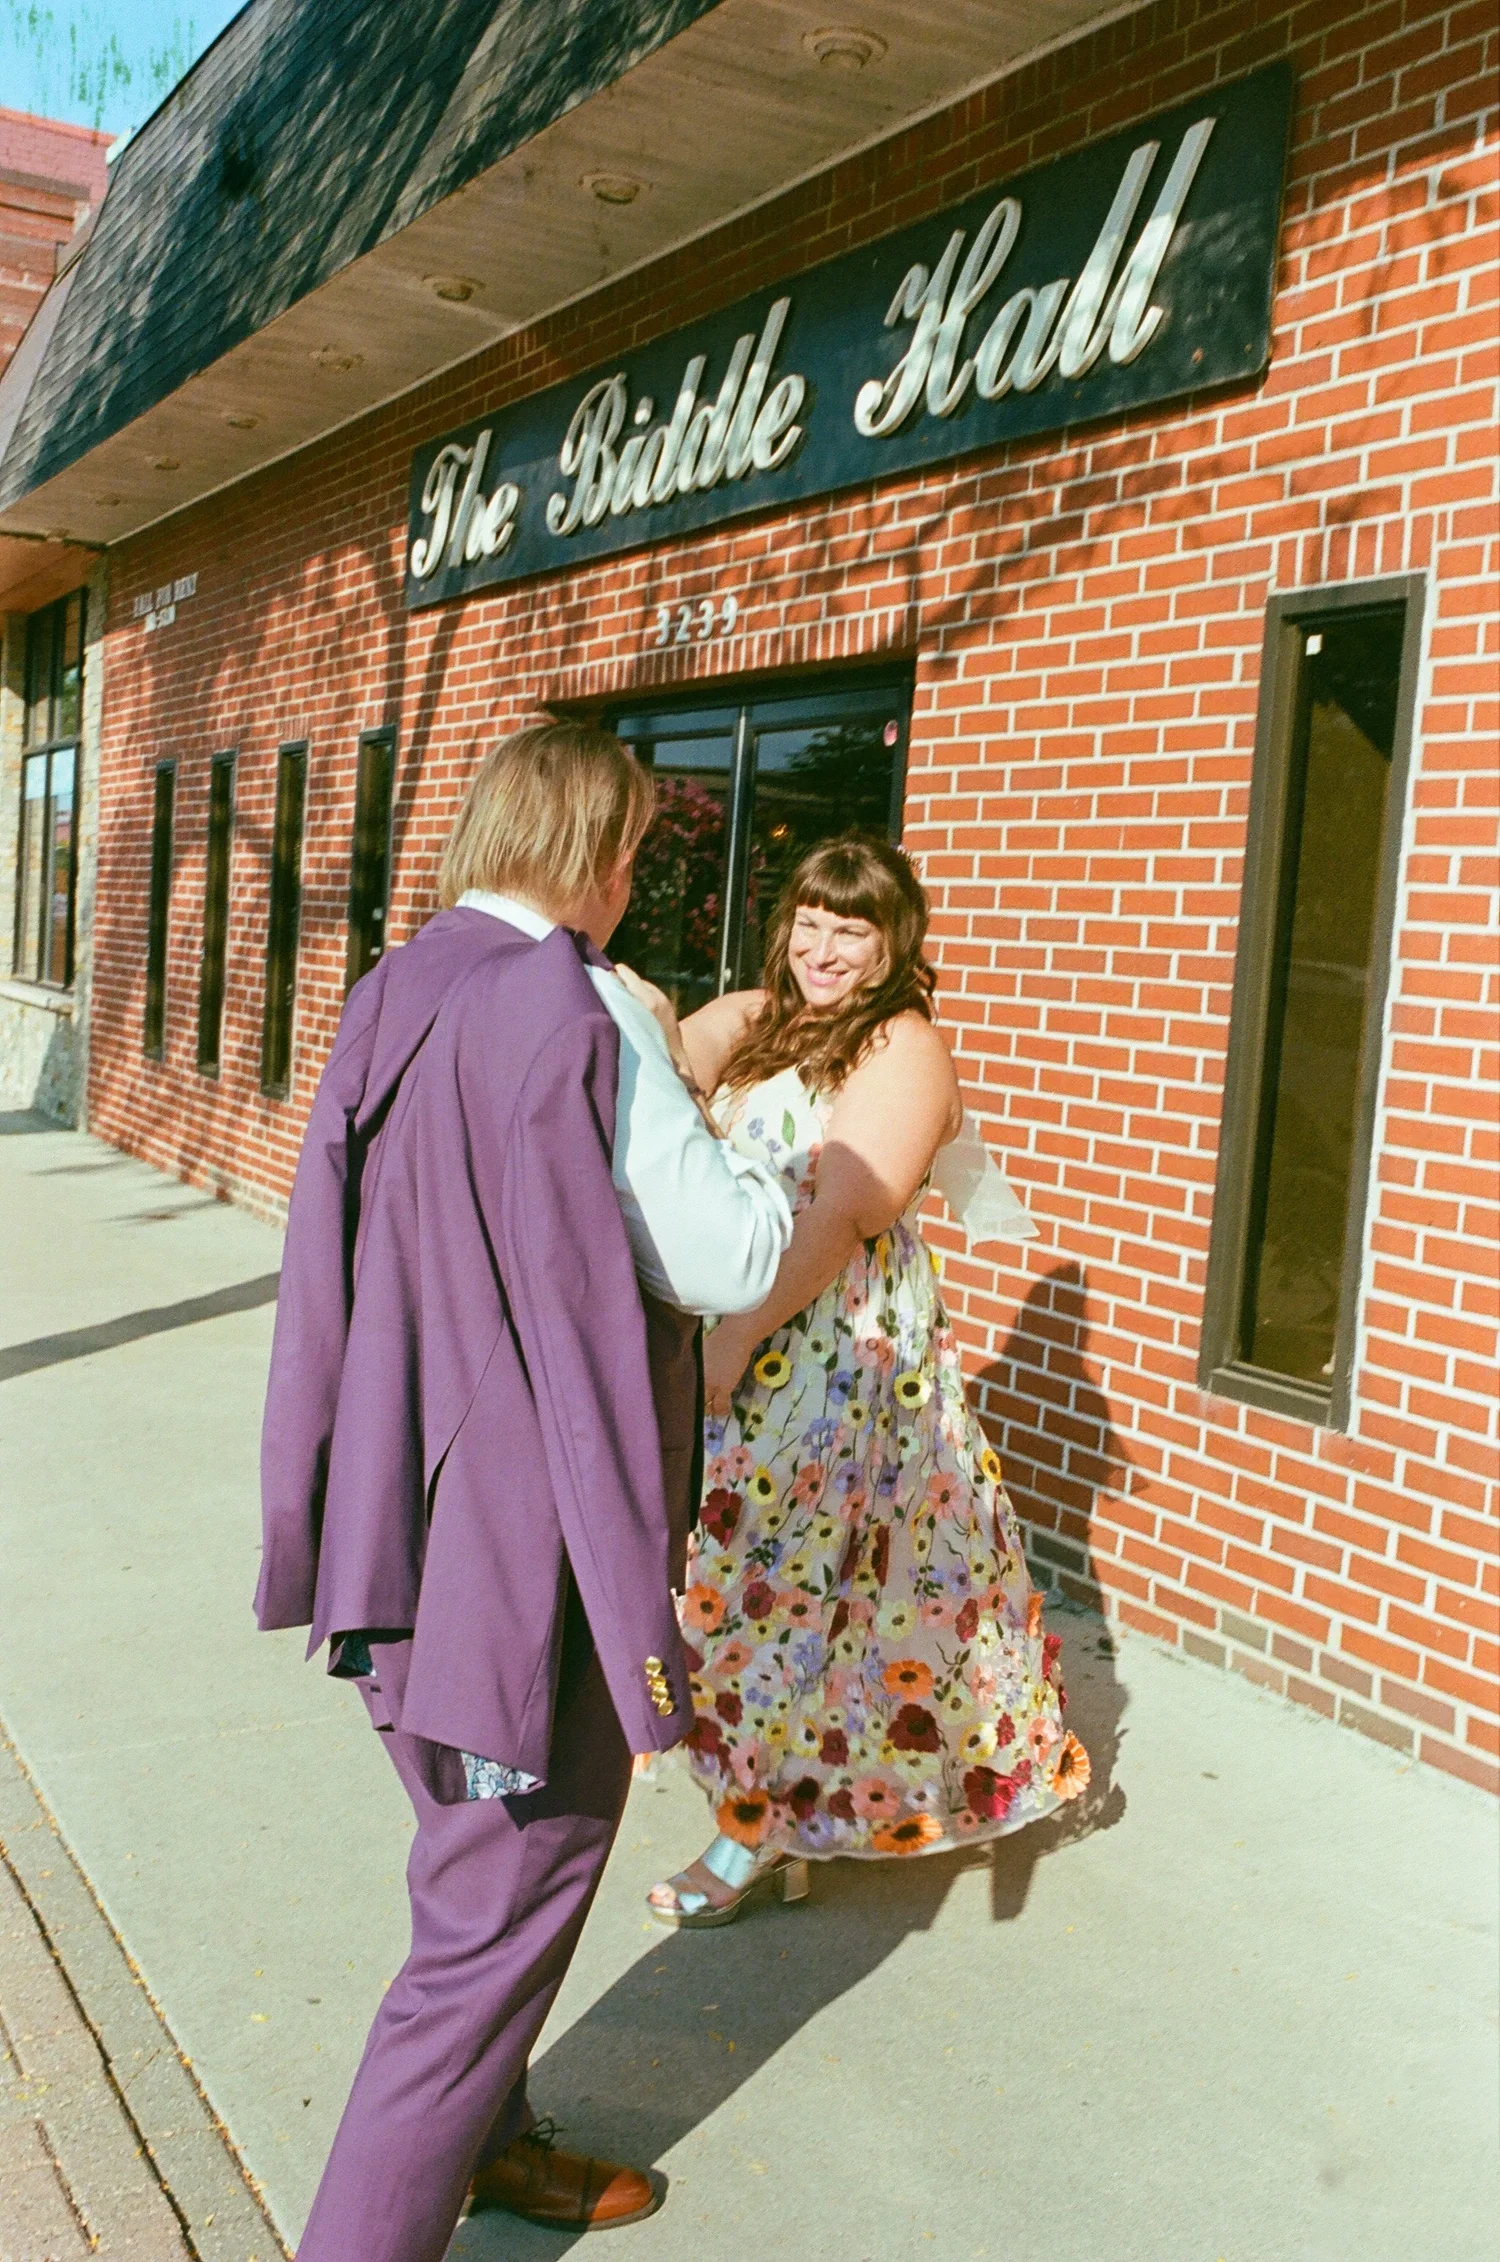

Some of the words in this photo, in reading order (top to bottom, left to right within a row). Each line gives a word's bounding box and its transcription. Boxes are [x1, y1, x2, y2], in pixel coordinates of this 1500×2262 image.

[411, 429, 519, 578] The
[546, 296, 805, 536] Biddle
[854, 116, 1216, 437] Hall
[655, 595, 738, 646] 3239
